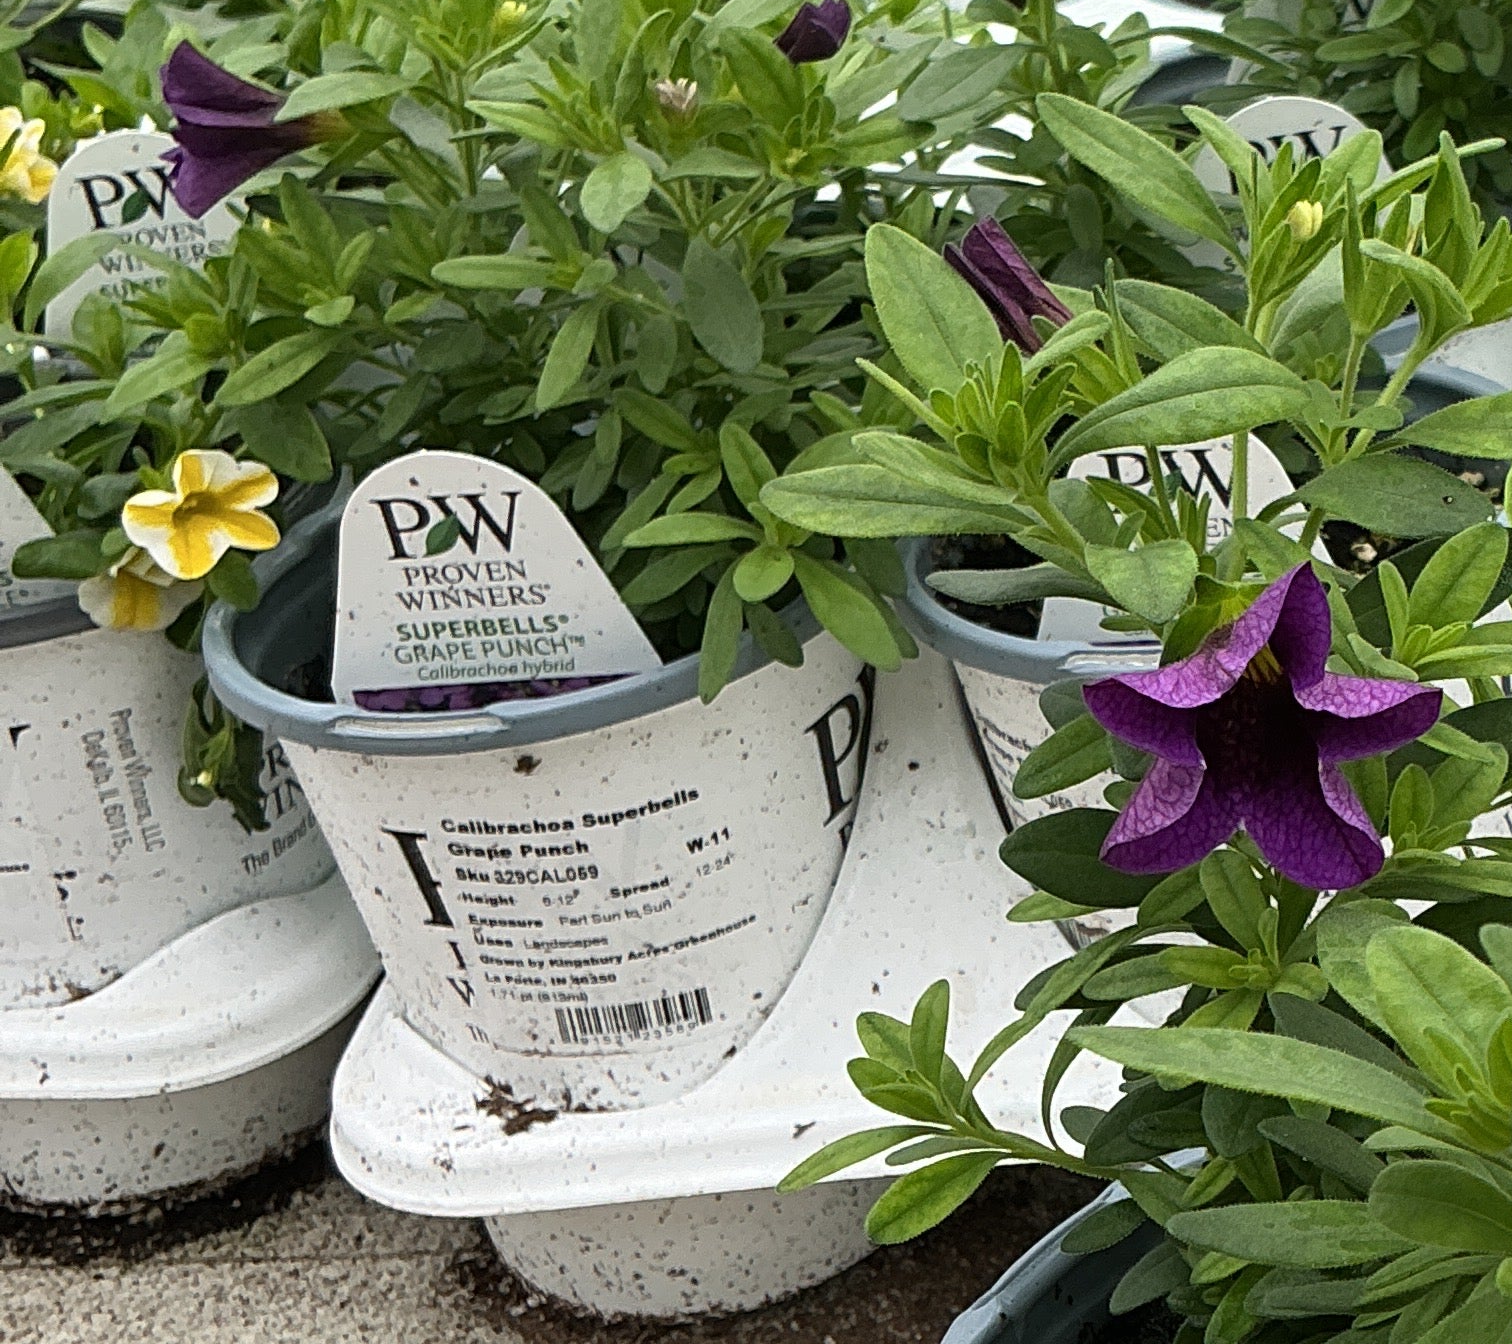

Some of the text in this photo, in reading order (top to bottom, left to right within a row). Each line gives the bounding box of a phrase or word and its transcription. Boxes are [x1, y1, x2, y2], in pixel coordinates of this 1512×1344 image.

[369, 491, 522, 561] PW
[402, 560, 528, 586] PROVEN
[394, 641, 477, 665] GRAPE
[418, 658, 576, 682] Calibrachoa hybrid
[441, 788, 699, 835] Calibrachoa Superbells
[141, 822, 167, 853] LLC
[447, 839, 589, 861] Grape Punch
[241, 849, 270, 876] The
[455, 866, 491, 884] Sku
[459, 891, 516, 907] Height
[609, 875, 670, 899] Spread
[468, 912, 543, 929] Exposure
[592, 910, 622, 924] Sun
[643, 899, 673, 916] Sun
[474, 930, 514, 948] Uses
[480, 954, 524, 968] Grown
[528, 957, 545, 970] by
[549, 954, 623, 969] Kingsbury
[674, 913, 757, 950] Greenhouse
